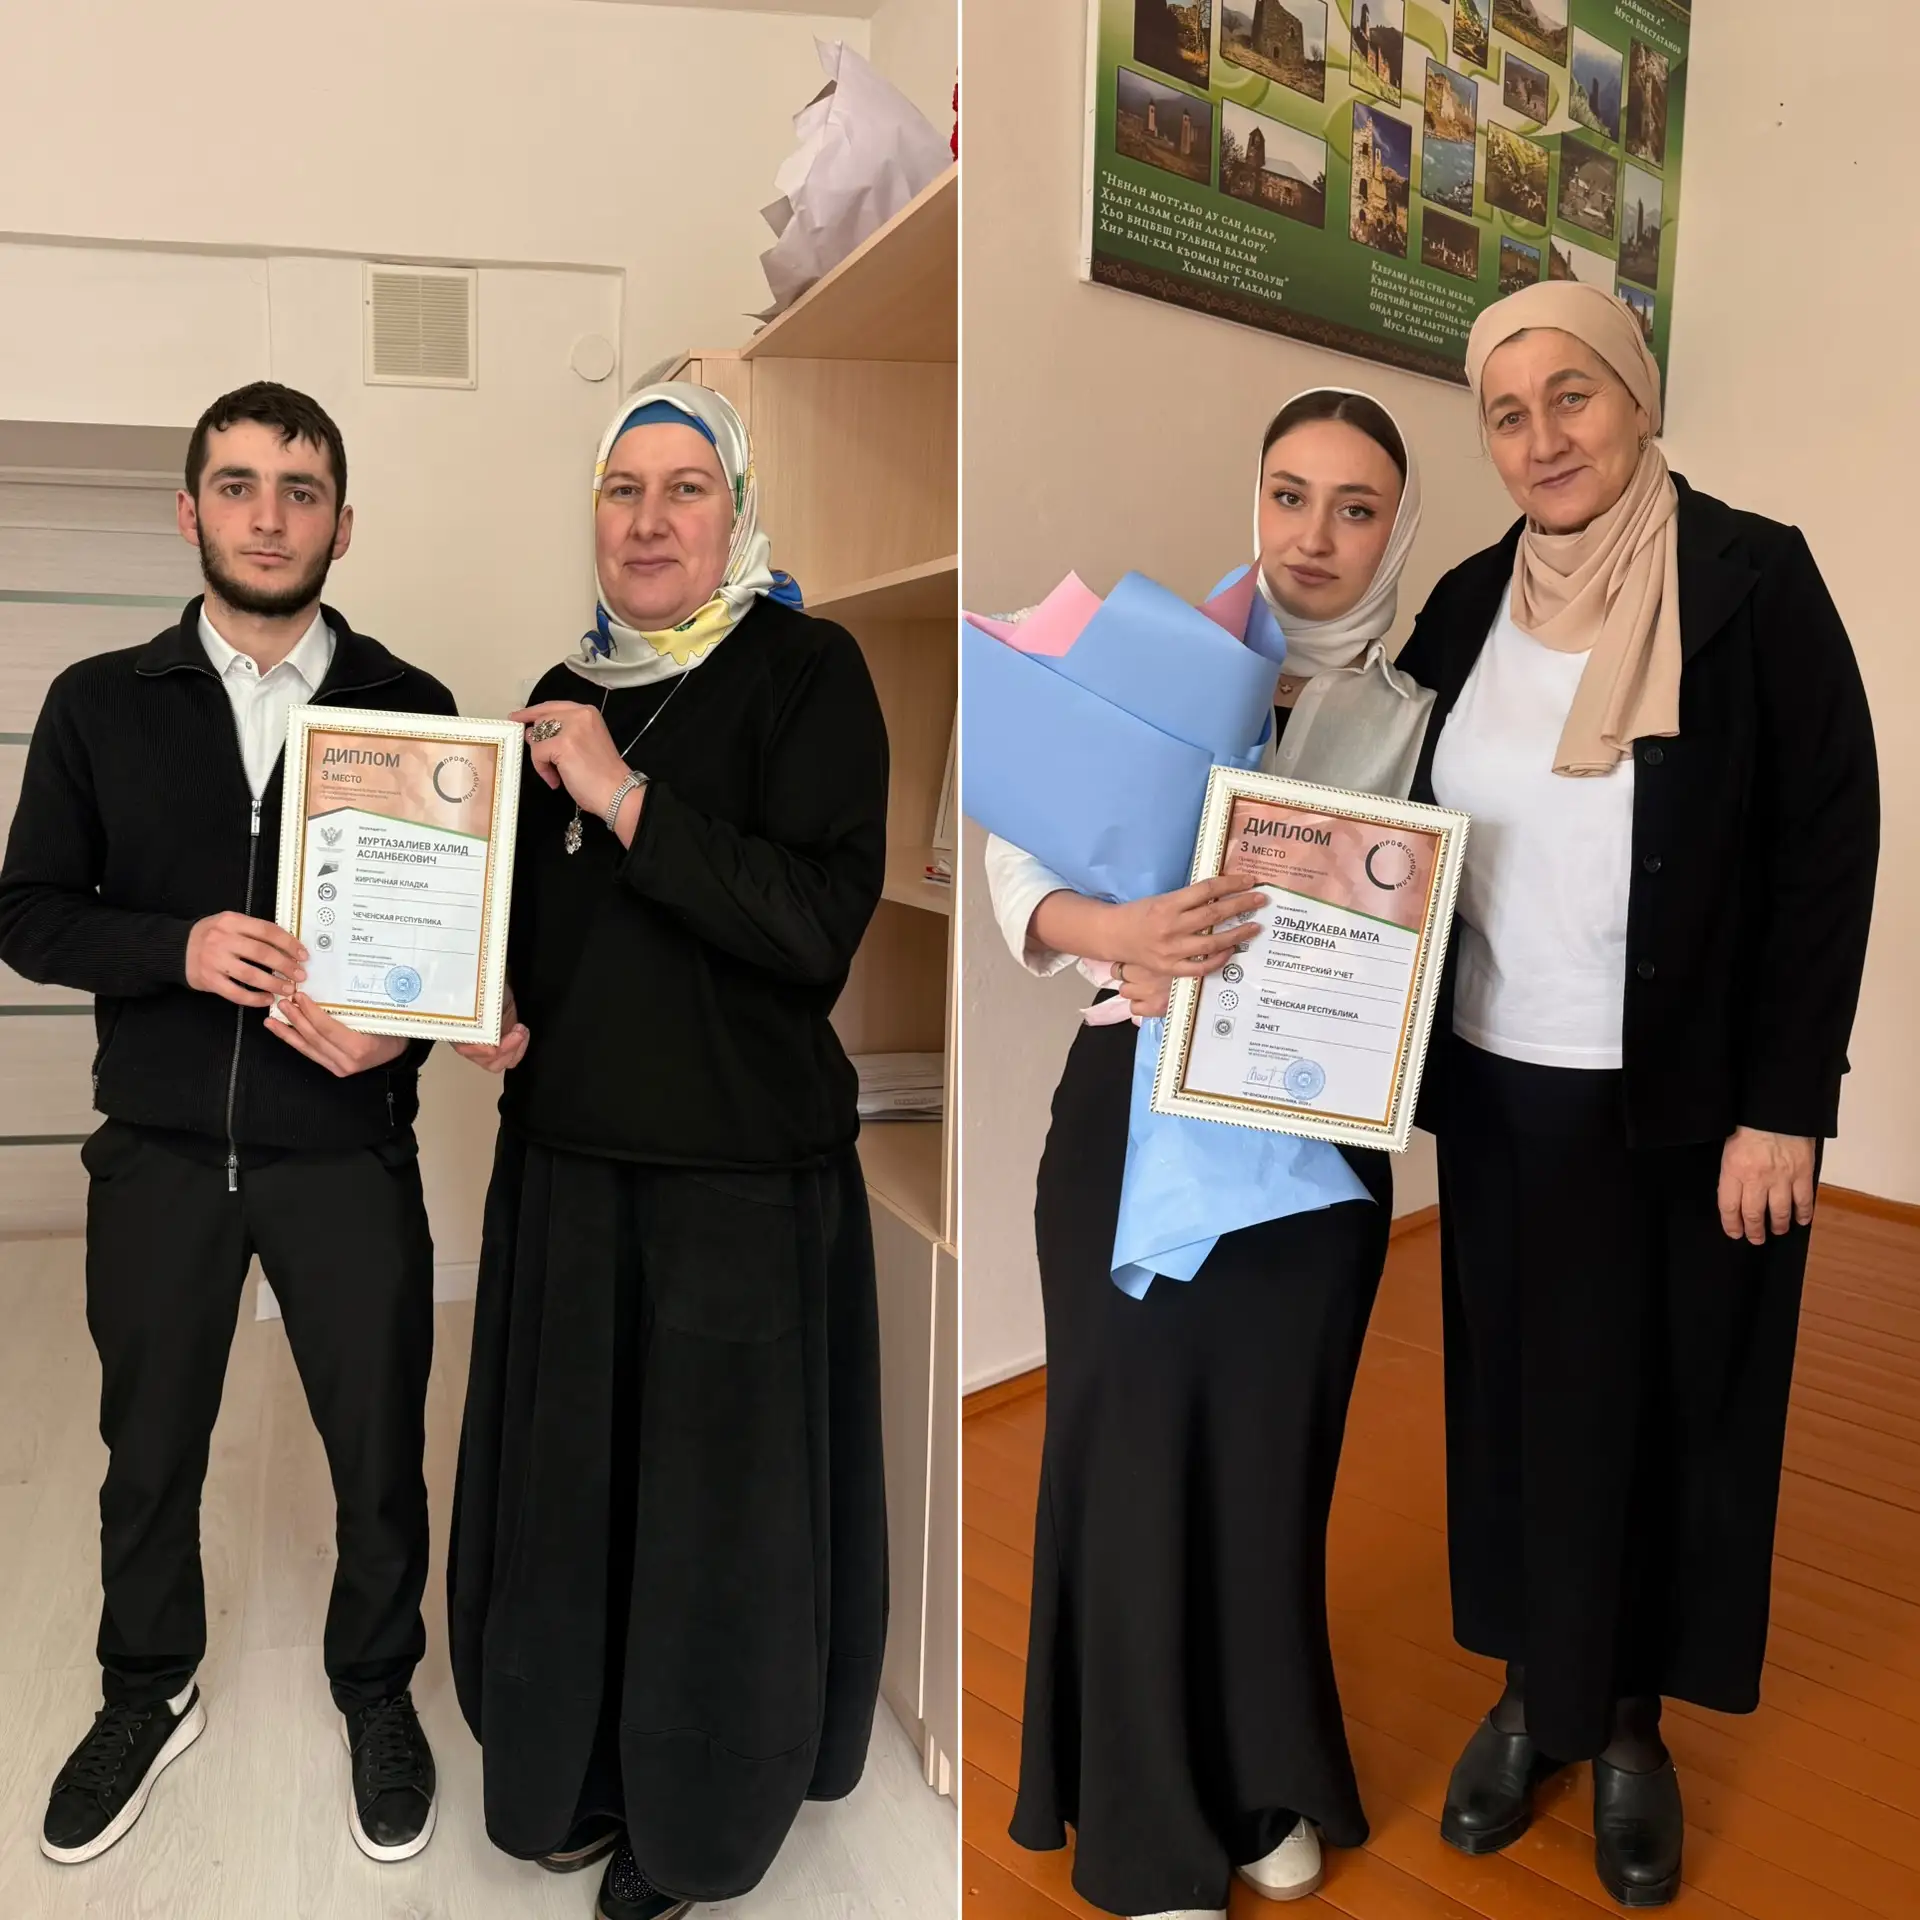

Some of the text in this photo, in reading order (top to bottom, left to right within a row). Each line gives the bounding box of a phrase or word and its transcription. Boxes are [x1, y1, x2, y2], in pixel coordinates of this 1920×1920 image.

[1100, 186, 1132, 207] ХЬАН
[1174, 214, 1202, 231] САЙН
[1100, 218, 1124, 235] ХИР
[1100, 202, 1124, 220] ХЬО
[1224, 246, 1258, 264] БАХАМ
[1222, 216, 1242, 229] САН
[1244, 224, 1276, 244] ДАХАР,
[322, 747, 400, 768] ДИПЛОМ
[322, 770, 362, 784] 3 МЕСТО
[444, 756, 480, 802] ПРОФЕССИОНАЛЫ
[1244, 818, 1332, 847] ДИПЛОМ
[358, 836, 431, 851] МУРТАЗАЛИЕВ
[434, 844, 469, 856] ХАЛИД
[1240, 842, 1286, 859] 3 МЕСТО
[357, 849, 437, 865] АСЛАНБЕКОВИЧ
[1380, 840, 1416, 888] ПРОФЕССИОНАЛЫ
[355, 876, 429, 890] КИРПИЧНАЯ КЛАДКА
[353, 911, 442, 926] ЧЕЧЕНСКАЯ РЕСПУБЛИКА
[351, 934, 374, 943] ЗАЧЕТ
[1274, 916, 1380, 943] ЭЛЬДУКАЕВА МАТА
[1272, 930, 1337, 950] УЗБЕКОВНА
[1266, 958, 1355, 980] БУХГАЛТЕРСКИЙ УЧЕТ
[1260, 996, 1359, 1020] ЧЕЧЕНСКАЯ РЕСПУБЛИКА
[1254, 1022, 1280, 1033] ЗАЧЕТ
